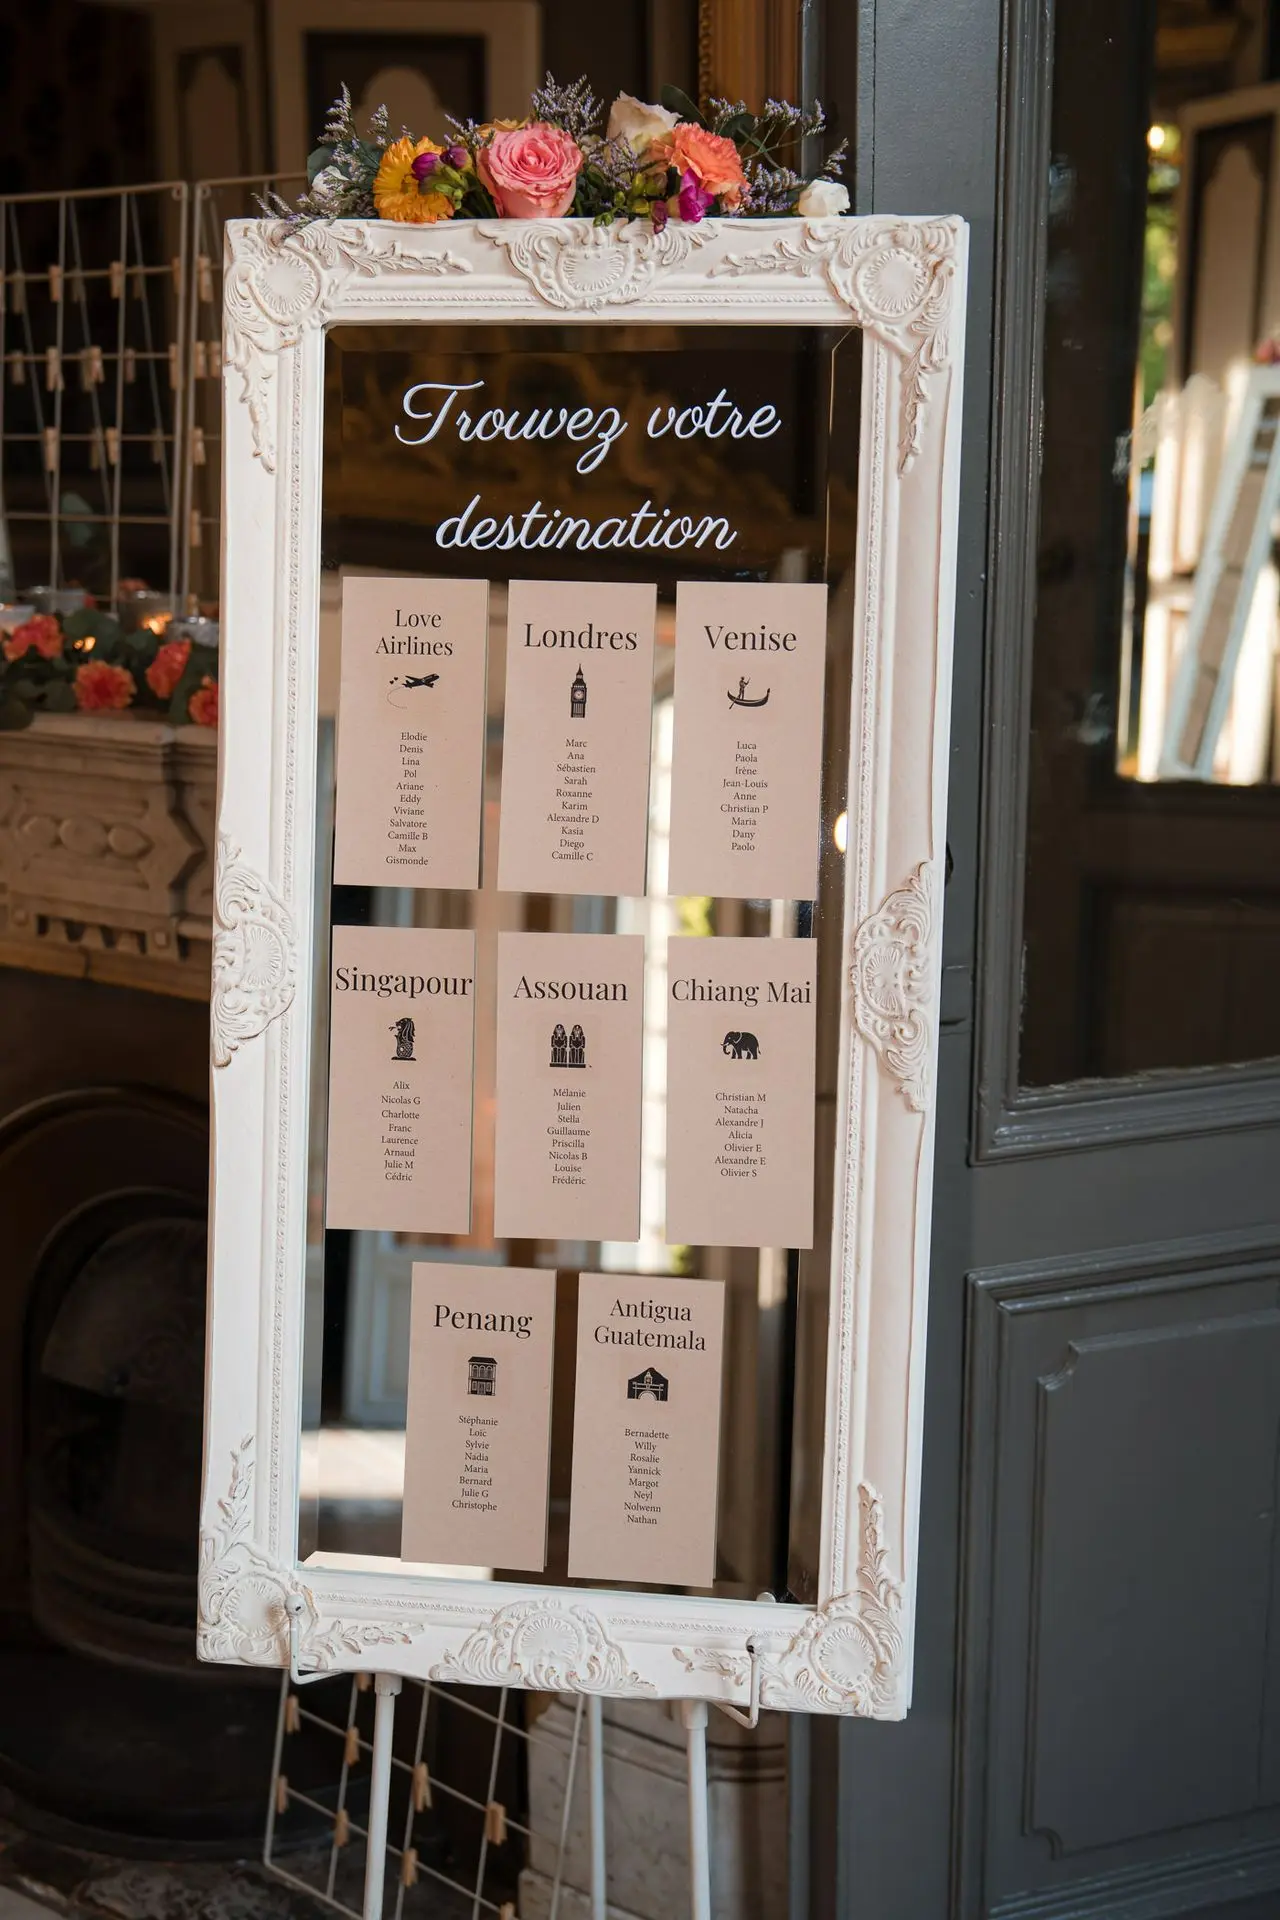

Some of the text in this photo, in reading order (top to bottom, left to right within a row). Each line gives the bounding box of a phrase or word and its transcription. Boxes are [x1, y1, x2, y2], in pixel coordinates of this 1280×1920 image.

[394, 380, 782, 475] Trouvez votre
[435, 494, 739, 551] destination
[395, 608, 442, 629] Love
[523, 622, 638, 651] Londres
[704, 625, 798, 653] Venise
[375, 635, 454, 658] Airlines
[401, 732, 428, 741] Elodie
[566, 739, 588, 748] Marc
[737, 741, 757, 750] Luca
[400, 744, 424, 754] Denis
[567, 752, 585, 760] Ana
[735, 754, 758, 763] Paola
[402, 758, 420, 766] Lina
[556, 764, 596, 773] Sébastien
[735, 767, 757, 775] Irène
[404, 770, 417, 778] Pol
[564, 776, 588, 786] Sarah
[723, 779, 769, 788] Jean-Louis
[396, 782, 425, 791] Ariane
[556, 789, 593, 798] Roxanne
[733, 792, 757, 801] Anne
[400, 795, 422, 805] Eddy
[562, 802, 588, 810] Karim
[720, 804, 769, 813] Christian P
[394, 807, 425, 816] Viviane
[390, 819, 428, 828] Salvatore
[547, 814, 600, 824] Alexandre D
[731, 817, 757, 826] Maria
[561, 826, 584, 835] Kasia
[732, 830, 756, 841] Dany
[388, 831, 428, 841] Camille B
[398, 844, 417, 853] Max
[560, 839, 585, 850] Diego
[731, 842, 756, 851] Paolo
[386, 856, 429, 866] Gismonde
[552, 851, 594, 861] Camille C
[335, 966, 473, 998] Singapour
[514, 975, 628, 1002] Assouan
[672, 978, 812, 1007] Chiang Mai
[393, 1081, 410, 1090] Alix
[553, 1088, 587, 1097] Mélanie
[715, 1092, 767, 1102] Christian M
[381, 1095, 421, 1105] Nicolas G
[556, 1102, 582, 1112] Julien
[724, 1106, 759, 1115] Natacha
[381, 1110, 420, 1120] Charlotte
[557, 1115, 580, 1124] Stella
[388, 1124, 412, 1132] Franc
[715, 1118, 764, 1129] Alexandre J
[547, 1127, 591, 1136] Guillaume
[728, 1131, 753, 1140] Alicia
[381, 1136, 419, 1145] Laurence
[552, 1139, 585, 1148] Priscilla
[384, 1148, 415, 1157] Arnaud
[724, 1144, 763, 1153] Olivier E
[549, 1151, 588, 1161] Nicolas B
[715, 1156, 767, 1166] Alexandre E
[383, 1160, 414, 1170] Julie M
[554, 1164, 583, 1173] Louise
[385, 1172, 413, 1182] Cédric
[720, 1169, 758, 1178] Olivier S
[552, 1176, 587, 1185] Frédéric
[610, 1299, 692, 1323] Antigua
[434, 1304, 533, 1339] Penang
[594, 1325, 707, 1351] Guatemala
[458, 1415, 499, 1427] Stéphanie
[469, 1428, 487, 1437] Loïc
[624, 1429, 670, 1440] Bernadette
[465, 1440, 490, 1452] Sylvie
[634, 1441, 657, 1453] Willy
[464, 1452, 489, 1462] Nadia
[630, 1453, 660, 1464] Rosalie
[464, 1465, 489, 1474] Maria
[628, 1465, 662, 1476] Yannick
[459, 1476, 493, 1486] Bernard
[628, 1478, 659, 1490] Margot
[461, 1488, 489, 1499] Julie G
[633, 1490, 653, 1501] Neyl
[452, 1500, 498, 1513] Christophe
[624, 1502, 662, 1513] Nolwenn
[627, 1514, 658, 1525] Nathan
